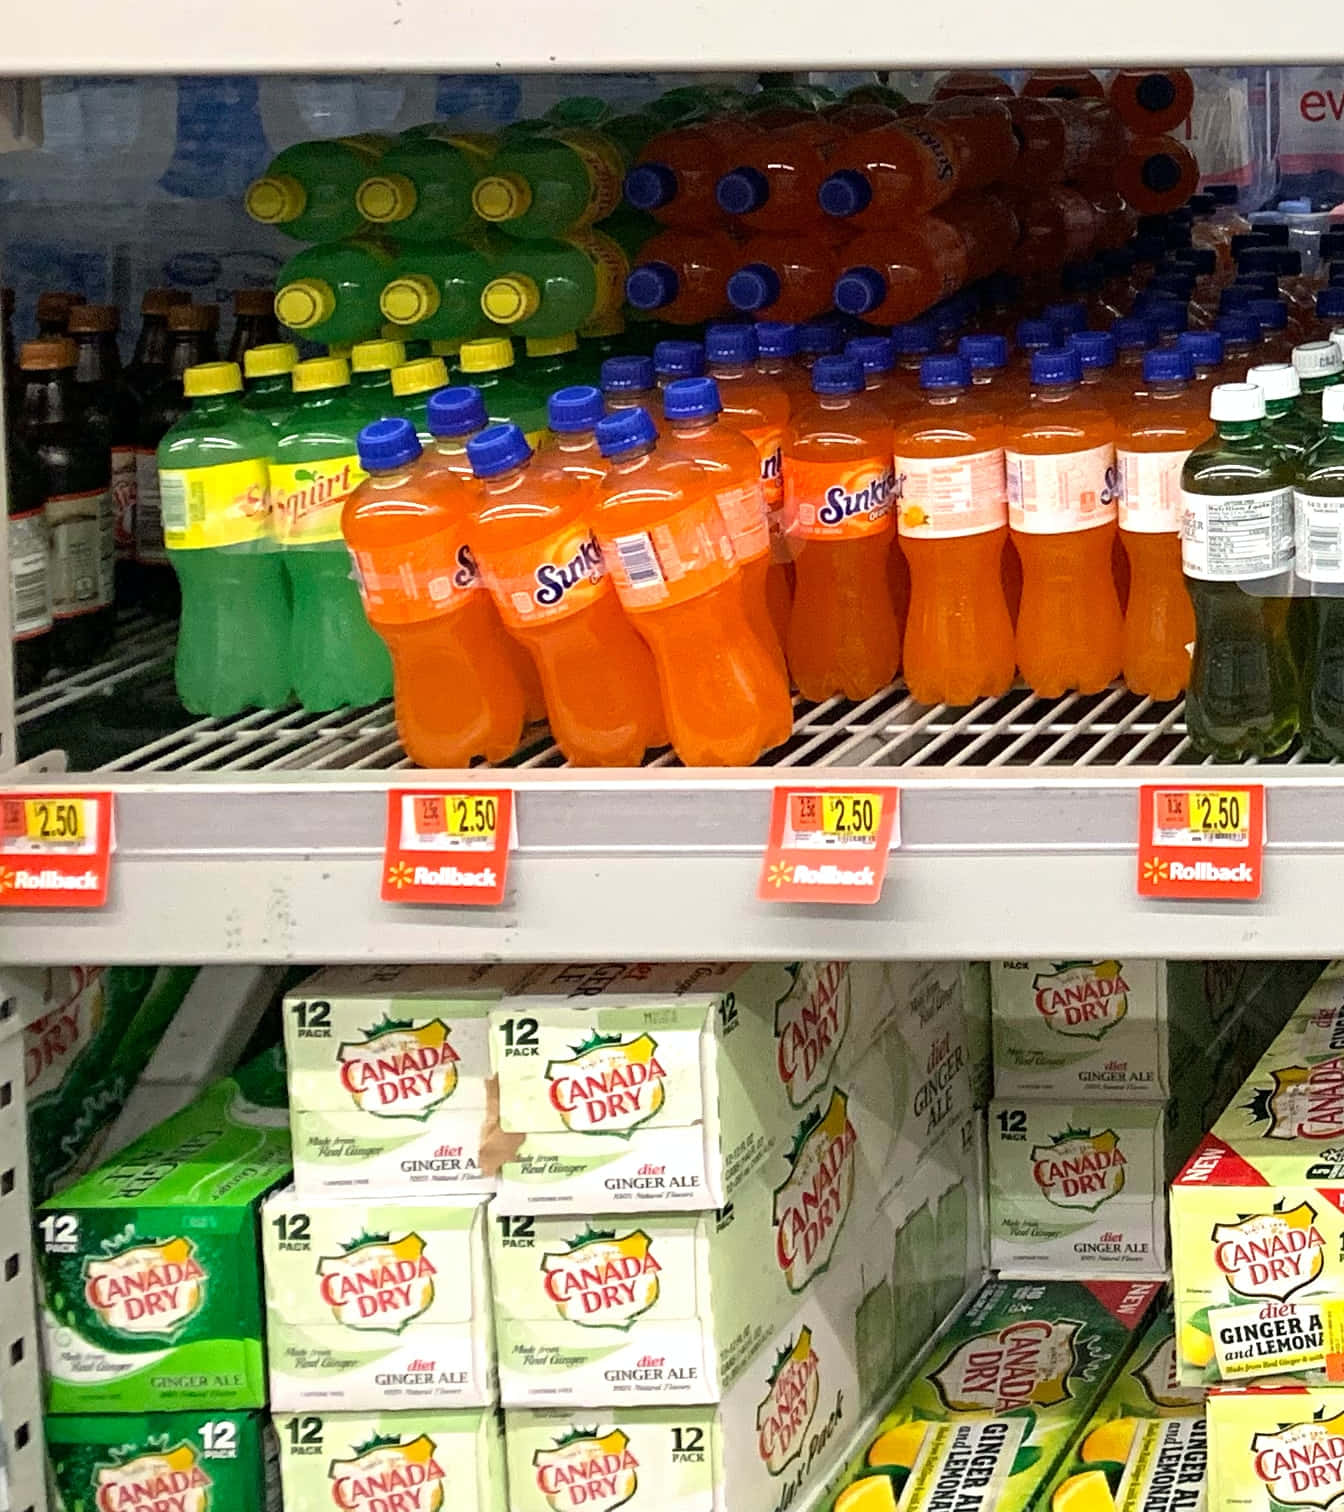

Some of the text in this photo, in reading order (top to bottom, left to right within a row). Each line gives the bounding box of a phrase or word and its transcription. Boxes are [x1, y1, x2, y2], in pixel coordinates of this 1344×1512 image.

[14, 870, 98, 890] Rollback
[414, 867, 497, 888] Rollback
[793, 864, 874, 886] Rollback
[1170, 862, 1253, 883] Rollback
[292, 1001, 331, 1028] 12
[499, 1019, 540, 1045] 12
[505, 1046, 540, 1056] PACK
[340, 1043, 461, 1094] CANADA
[378, 1071, 434, 1105] DRY
[549, 1057, 667, 1112] CANADA
[586, 1092, 641, 1124] DRY
[636, 1162, 666, 1176] diet
[604, 1175, 700, 1190] GINGER ALE
[1215, 1229, 1327, 1274] CANADA
[1249, 1255, 1303, 1287] DRY
[1259, 1302, 1297, 1320] diet
[1220, 1321, 1303, 1346] GINGER
[1225, 1346, 1254, 1362] and
